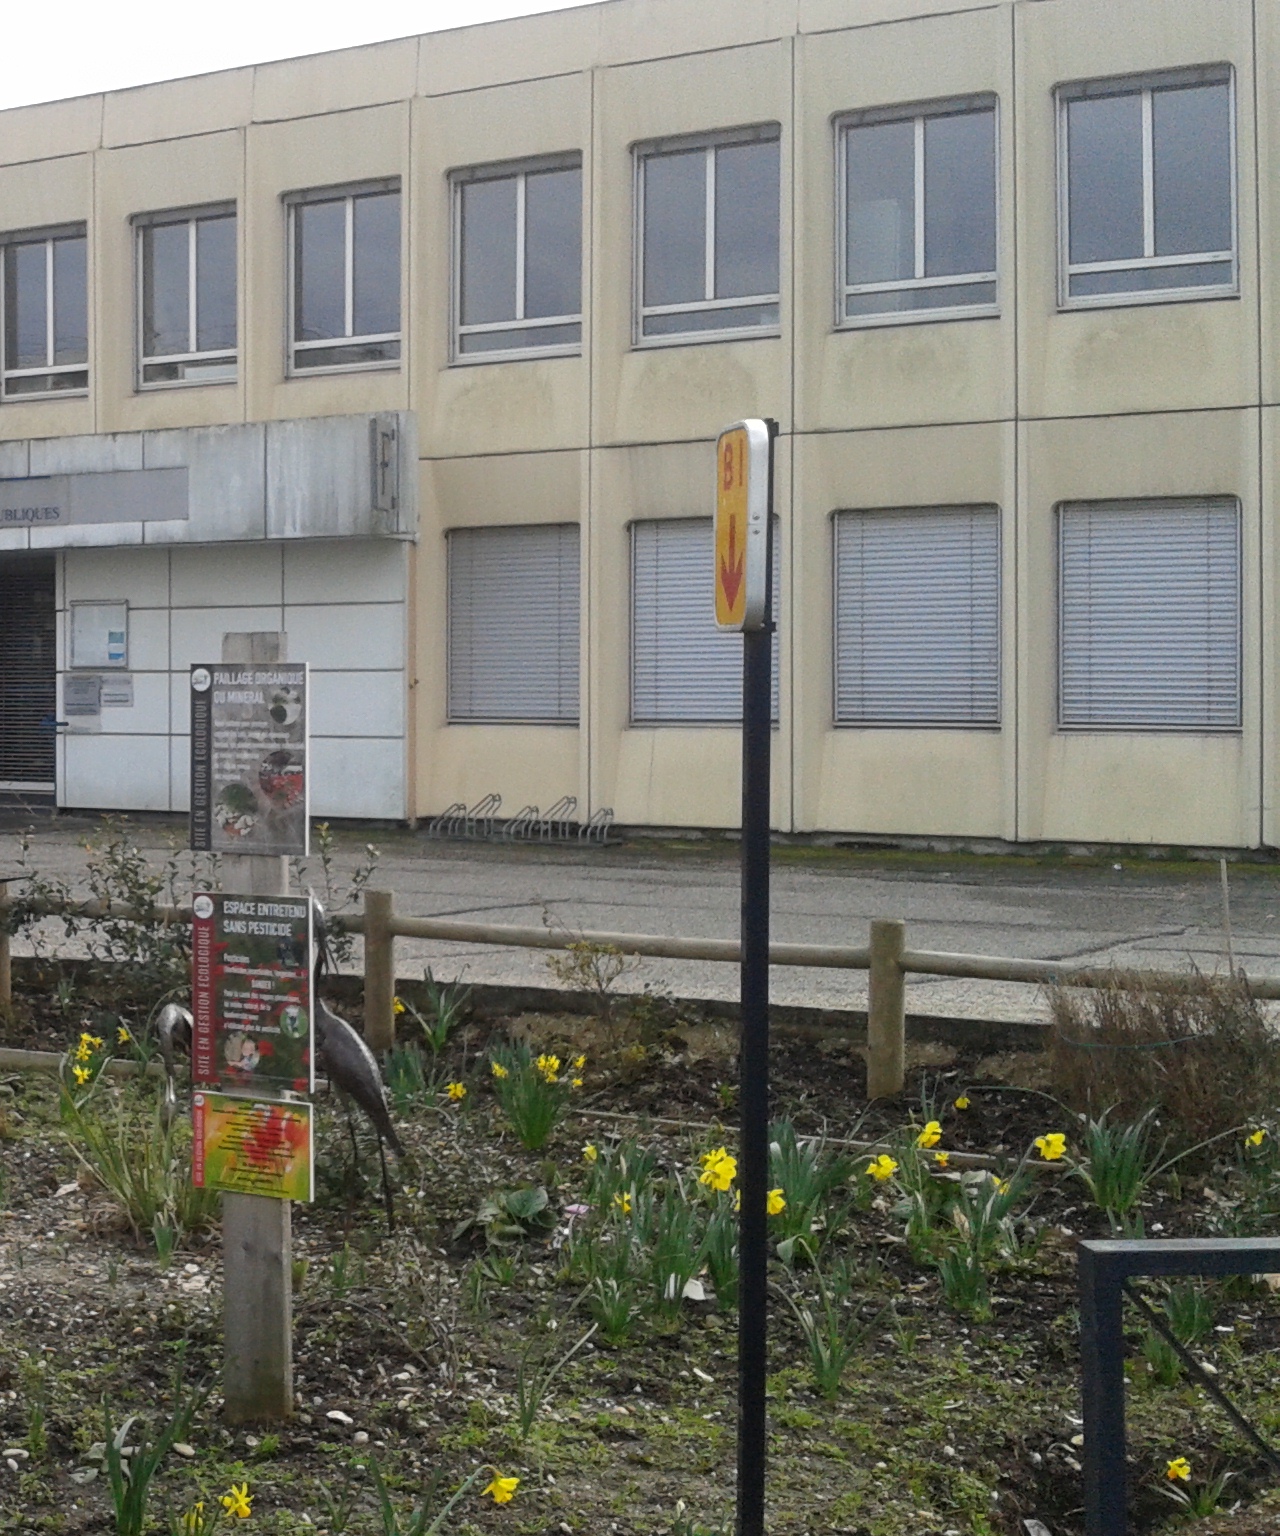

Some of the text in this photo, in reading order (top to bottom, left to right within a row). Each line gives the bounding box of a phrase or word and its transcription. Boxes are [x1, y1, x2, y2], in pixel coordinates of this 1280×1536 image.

[254, 671, 305, 685] ORGANIQUE
[213, 690, 226, 704] OU
[194, 764, 207, 806] GESTION
[194, 809, 207, 823] EN
[194, 827, 207, 848] SITE
[223, 900, 256, 916] ESPACE
[257, 903, 307, 919] ENTRETENU
[223, 919, 293, 937] SANS PESTICIDE
[197, 990, 210, 1034] GESTION
[197, 1037, 210, 1051] EN
[197, 1054, 210, 1076] SITE
